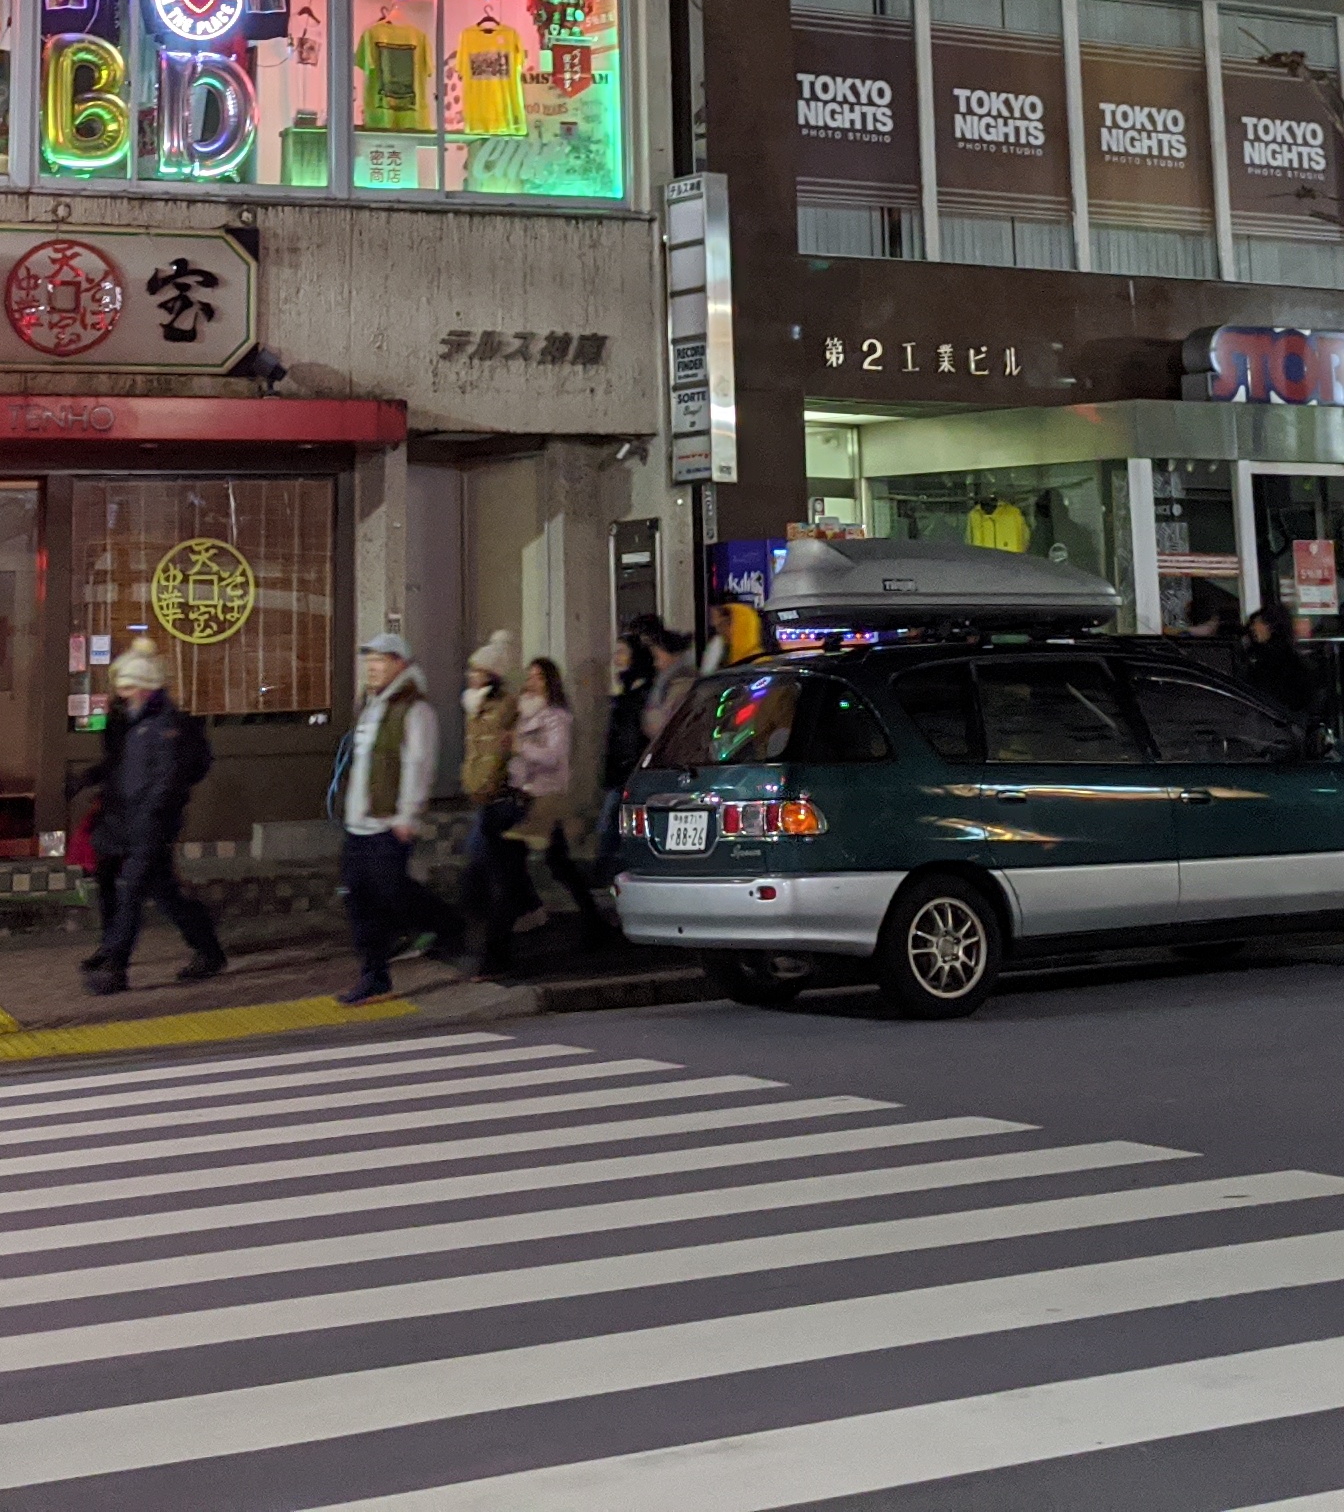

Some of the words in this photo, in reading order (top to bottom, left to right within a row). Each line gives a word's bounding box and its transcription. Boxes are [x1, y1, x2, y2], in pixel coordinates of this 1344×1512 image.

[167, 6, 193, 33] THE
[196, 2, 236, 35] PLACE
[795, 73, 893, 106] TOKYO
[953, 88, 1044, 120] TOKYO
[797, 100, 894, 133] NIGHTS
[954, 113, 1045, 146] NIGHTS
[1099, 102, 1185, 133] TOKYO
[1241, 116, 1324, 146] TOKYO
[801, 128, 842, 140] PHOTO
[847, 129, 892, 144] STUDIO
[957, 141, 997, 153] PHOTO
[1001, 143, 1044, 157] STUDIO
[1100, 126, 1188, 159] NIGHTS
[369, 148, 403, 167] 密売
[1104, 154, 1141, 166] PHOTO
[1145, 157, 1186, 170] STUDIO
[1243, 141, 1327, 171] NIGHTS
[369, 167, 402, 185] 商店
[1246, 166, 1283, 178] PHOTO
[1286, 168, 1326, 182] STUDIO
[12, 264, 46, 340] 中華
[676, 344, 705, 359] RECORD
[677, 358, 704, 373] FINDER
[824, 336, 1022, 377] 第2工業ビル
[676, 390, 707, 405] SORTE
[8, 404, 116, 432] TENHO
[157, 562, 186, 629] 中華
[216, 564, 246, 622] そば
[675, 826, 705, 847] 88-26
